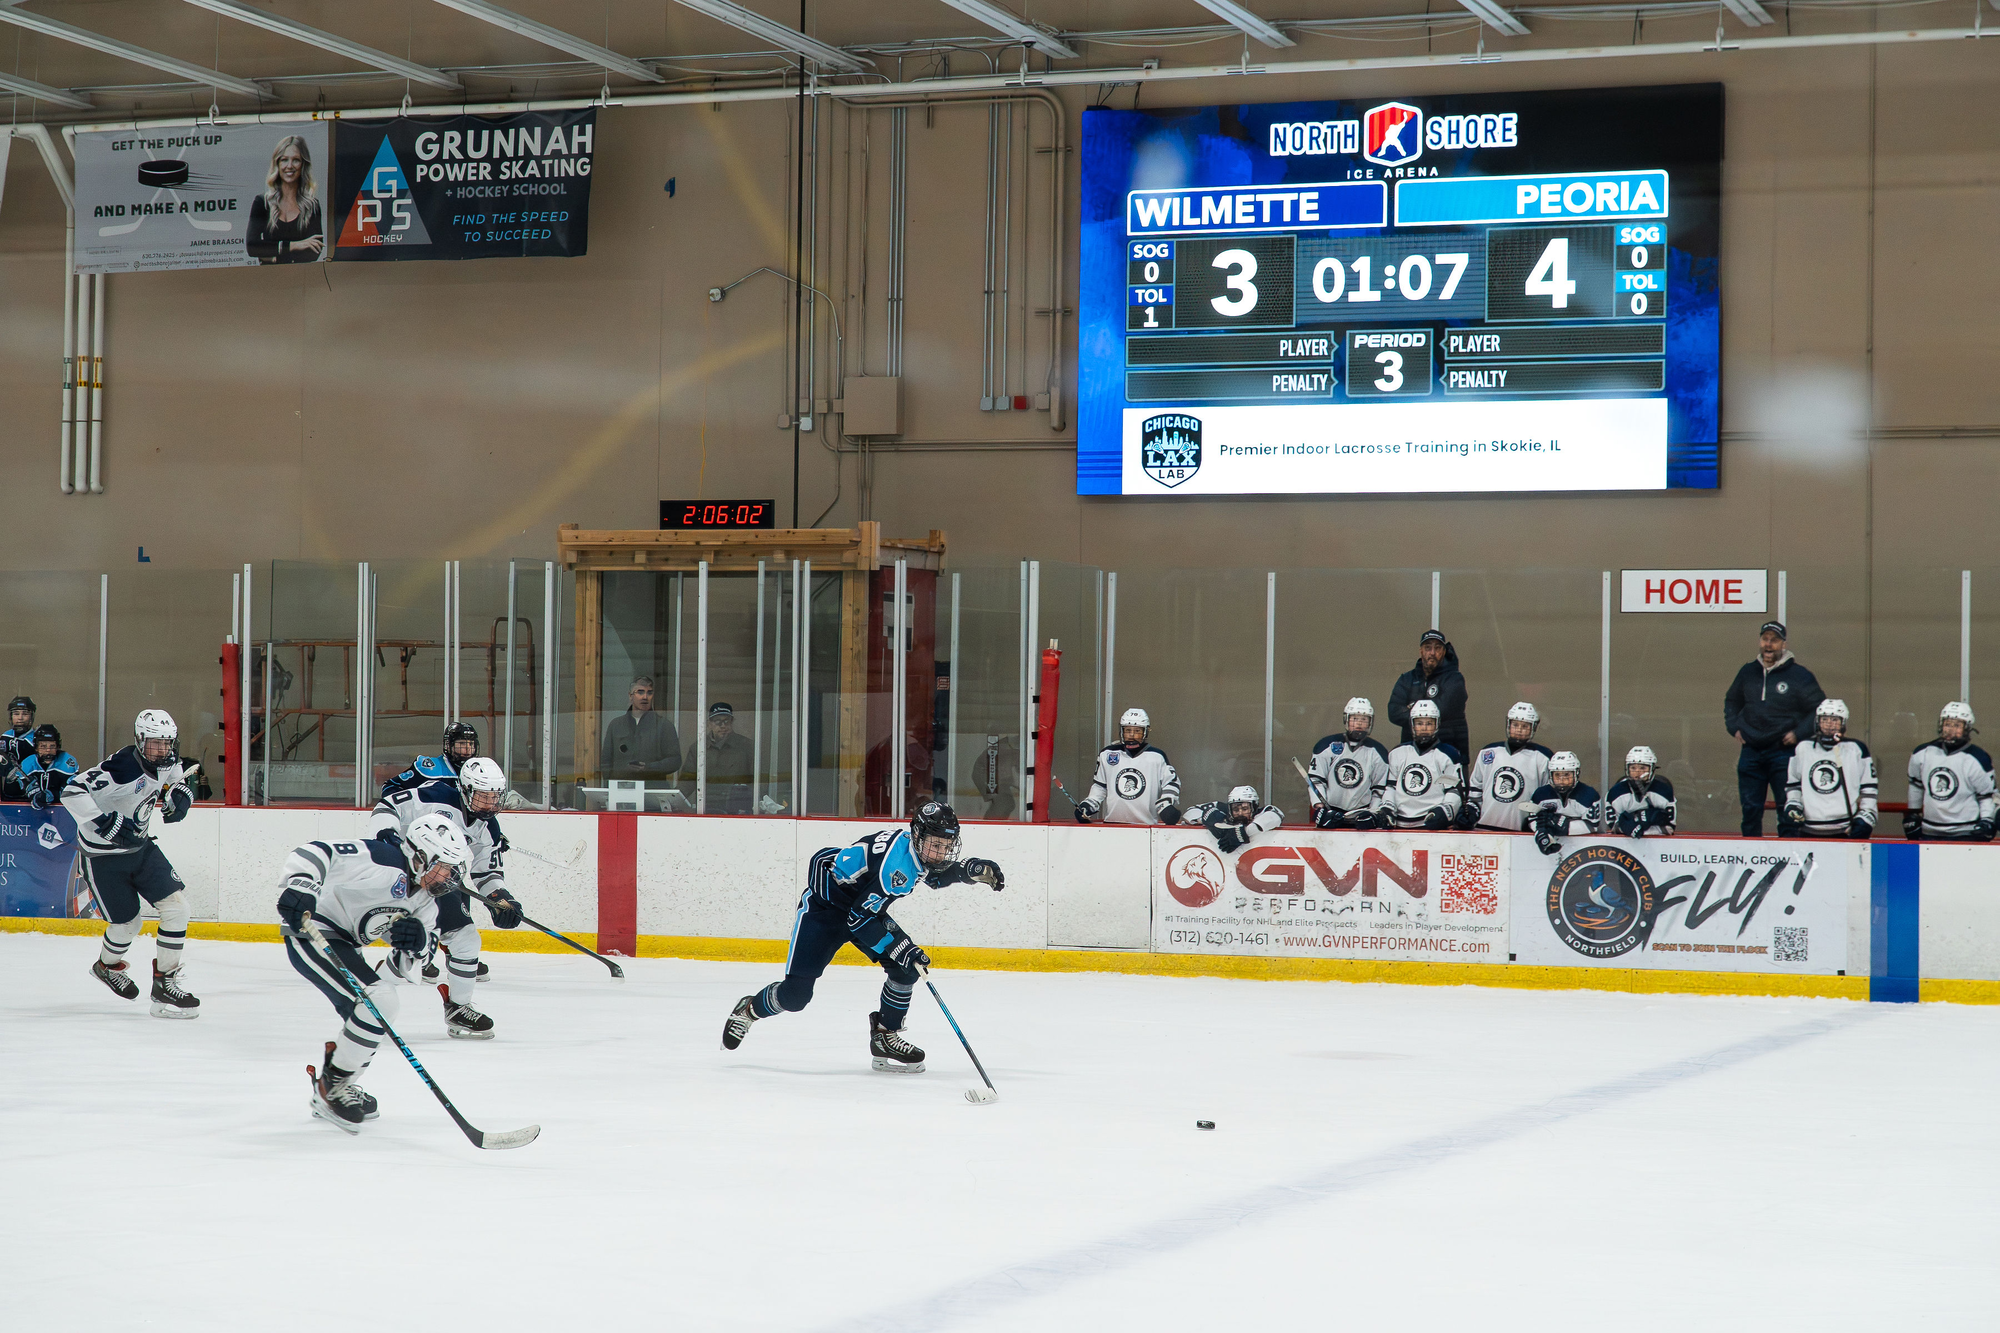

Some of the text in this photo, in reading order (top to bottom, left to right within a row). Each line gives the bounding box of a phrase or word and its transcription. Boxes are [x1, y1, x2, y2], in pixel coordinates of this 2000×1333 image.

[112, 135, 222, 151] GET THE PUCK UP
[415, 124, 593, 161] GRUNNAH
[1271, 114, 1517, 155] NORTH SHORE
[416, 158, 591, 182] POWER SKATING
[1347, 167, 1439, 180] ICE ARENA
[457, 185, 509, 199] HOCKEY
[512, 183, 567, 197] SCHOOL
[1516, 180, 1660, 214] PEORIA
[94, 198, 237, 218] AND MAKE A MOVE
[1135, 192, 1320, 227] WILMETTE
[452, 211, 569, 226] FIND THE SPEED
[190, 238, 245, 247] JAIME BRAASCH
[363, 234, 403, 244] HOCKEY
[464, 229, 552, 242] TO SUCCEED
[1620, 227, 1660, 243] SOG
[1133, 243, 1169, 259] SOG
[1631, 246, 1648, 269] 0
[1144, 261, 1160, 283] 0
[1312, 253, 1470, 303] 01:07
[1525, 237, 1576, 309] 4
[1211, 249, 1259, 316] 3
[1622, 274, 1658, 290] TOL
[1135, 288, 1168, 303] TOL
[1631, 293, 1648, 315] 0
[1143, 306, 1159, 328] 1
[1280, 338, 1328, 357] PLAYER
[1354, 333, 1426, 348] PERIOD
[1450, 334, 1501, 353] PLAYER
[1374, 350, 1404, 392] 3
[1450, 370, 1508, 388] PENALTY
[1272, 374, 1328, 392] PENALTY
[1145, 416, 1199, 433] CHICAGO
[1220, 438, 1561, 456] Premier Indoor Lacrosse Training in Skokie, IL
[1146, 450, 1196, 467] LAX
[1158, 469, 1185, 479] LAB
[683, 505, 763, 524] 2:06:02
[1644, 578, 1743, 605] HOME
[0, 824, 31, 837] RUST
[1556, 853, 1582, 881] NEST
[1587, 848, 1640, 872] HOCKEY
[1660, 854, 1700, 864] BUILD,
[1704, 855, 1747, 866] LEARN,
[1235, 845, 1429, 899] GVN
[1550, 884, 1560, 911] THE
[1639, 875, 1653, 911] CLUB
[1165, 915, 1174, 923] #1
[1176, 915, 1209, 925] Training
[1211, 916, 1241, 926] Facility
[1242, 917, 1254, 925] for
[1257, 918, 1275, 926] NHL
[1277, 918, 1292, 926] and
[1295, 919, 1313, 927] Elite
[1370, 921, 1403, 930] Leaders
[1405, 922, 1413, 930] in
[1416, 923, 1442, 932] Player
[1445, 924, 1503, 933] Development
[1169, 930, 1201, 946] (312)
[1283, 934, 1490, 953] www.GVNPERFORMANCE.com
[1564, 934, 1636, 955] NORTHFIELD
[1652, 943, 1769, 954] SCAN TO JOIN THE FLOCK
